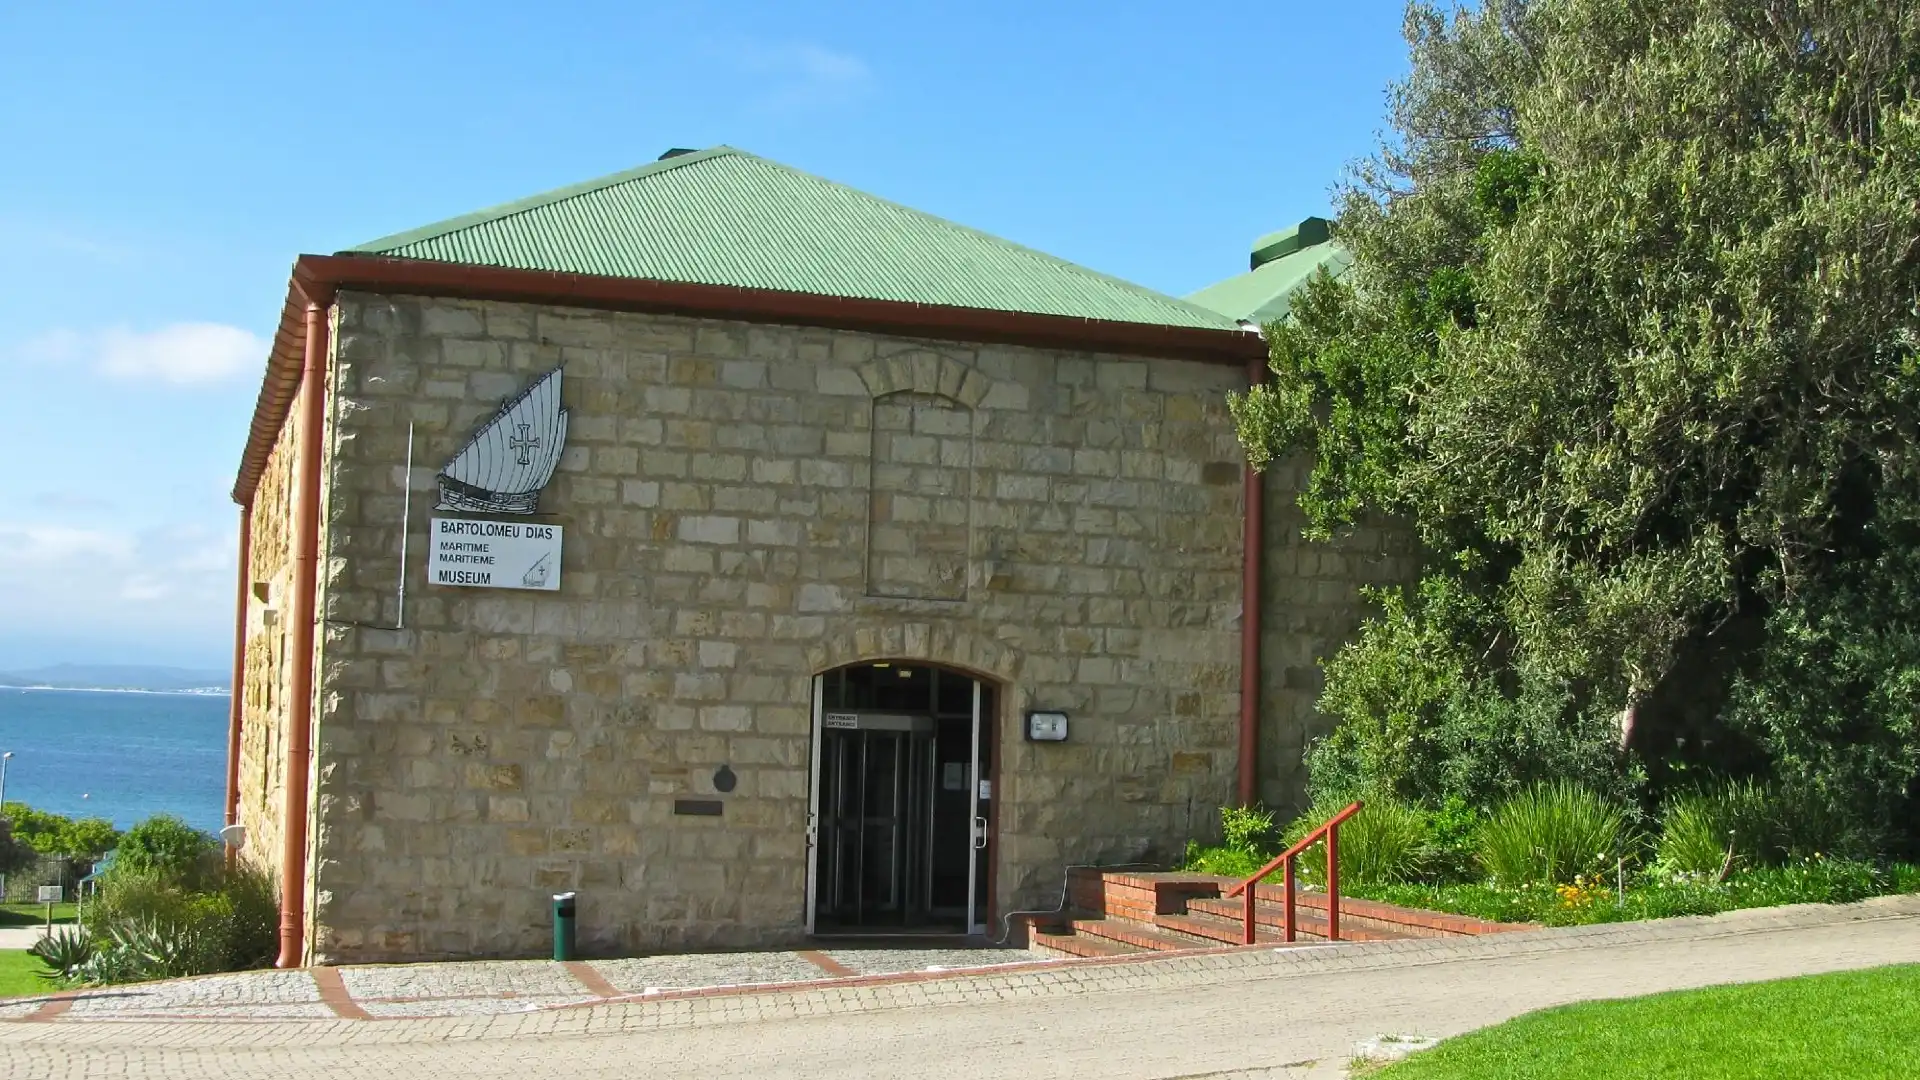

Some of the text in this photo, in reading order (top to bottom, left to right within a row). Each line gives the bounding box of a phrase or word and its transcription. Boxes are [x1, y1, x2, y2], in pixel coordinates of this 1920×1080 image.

[441, 521, 553, 540] BARTOLOMEU DIAS
[440, 542, 490, 553] MARITIME
[439, 553, 495, 565] MARITIEME
[438, 570, 491, 584] MUSEUM
